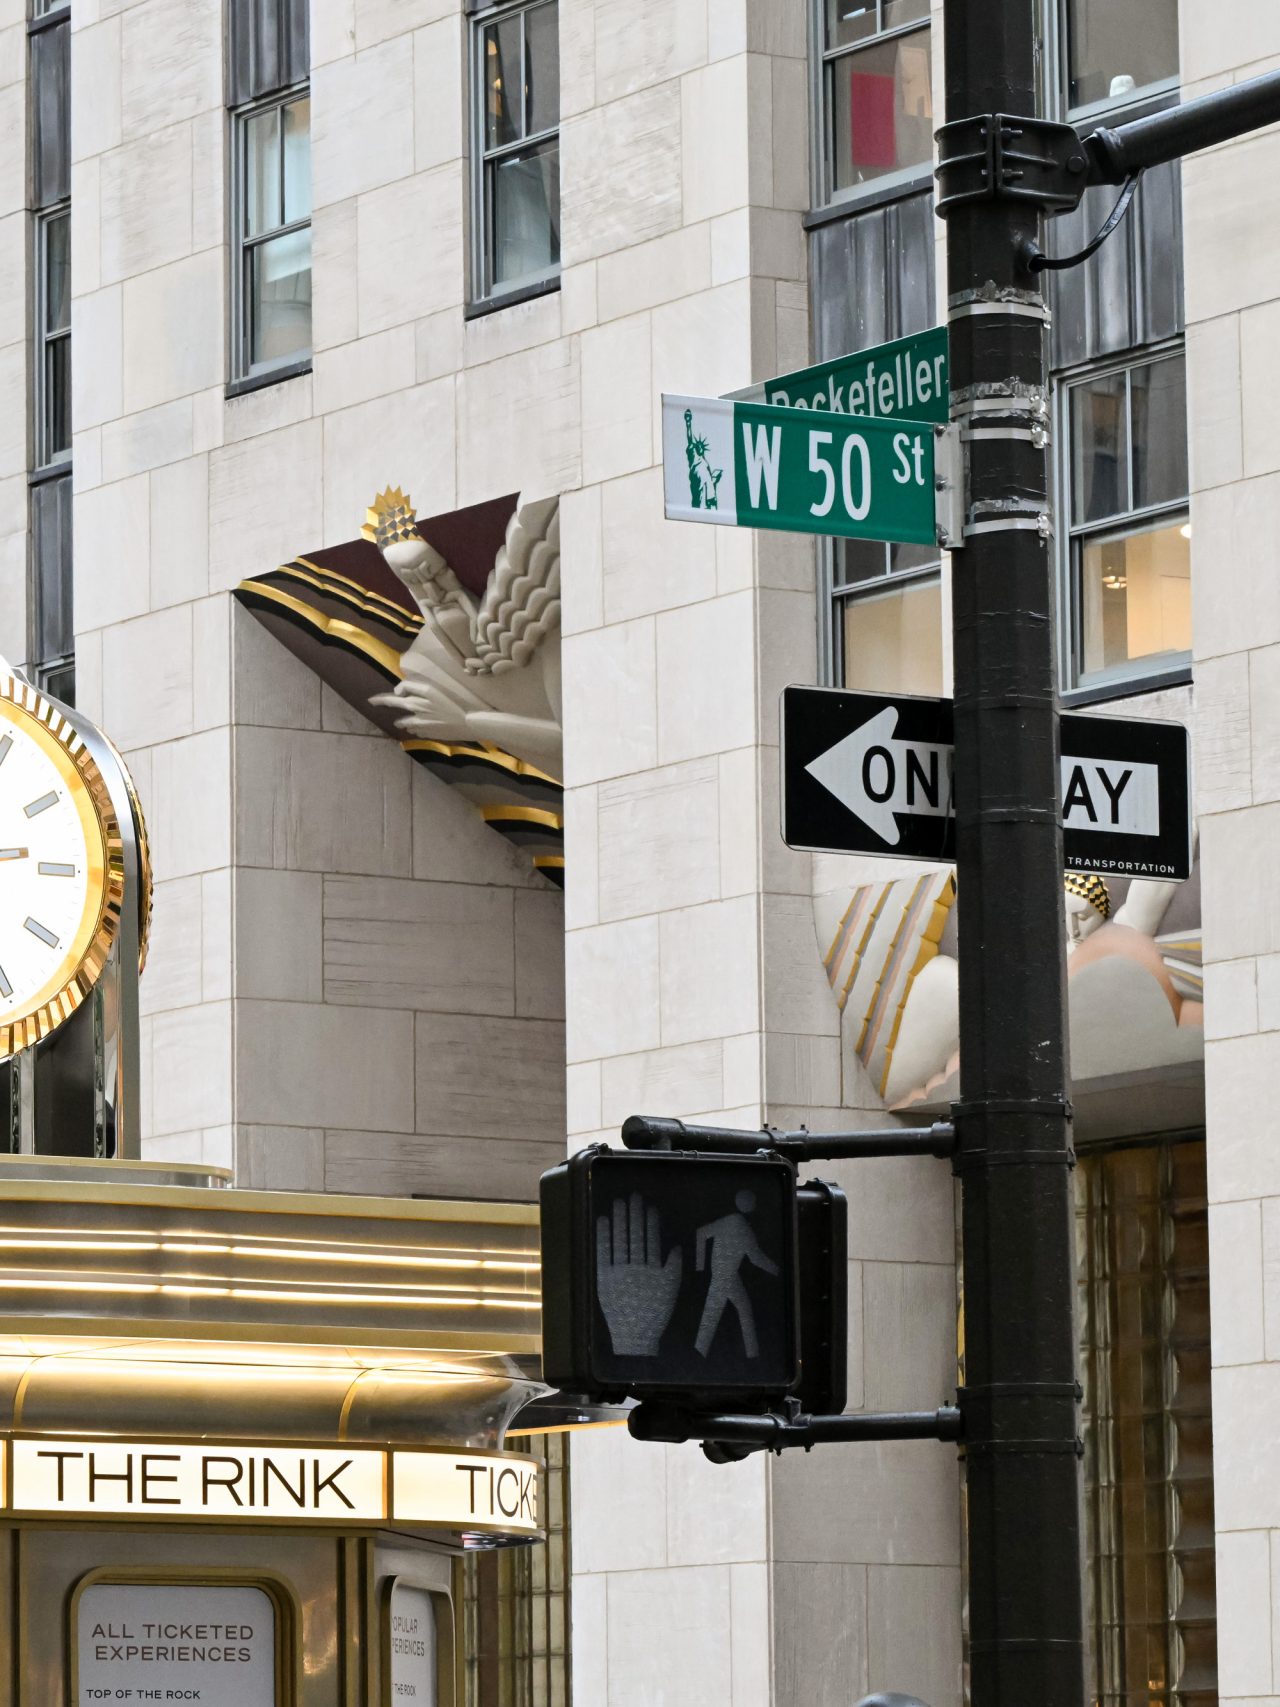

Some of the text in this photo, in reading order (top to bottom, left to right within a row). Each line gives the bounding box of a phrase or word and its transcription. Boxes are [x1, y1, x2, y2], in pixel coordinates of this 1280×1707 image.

[742, 422, 925, 521] W 50 St
[862, 745, 1133, 824] ON AY
[1067, 856, 1175, 874] TRANSPORTATION
[37, 1451, 356, 1510] THE RINK
[92, 1623, 254, 1640] ALL TICKETED
[391, 1616, 418, 1633] OPULAR
[95, 1645, 251, 1662] EXPERIENCES
[86, 1689, 201, 1700] TOP OF THE ROCK
